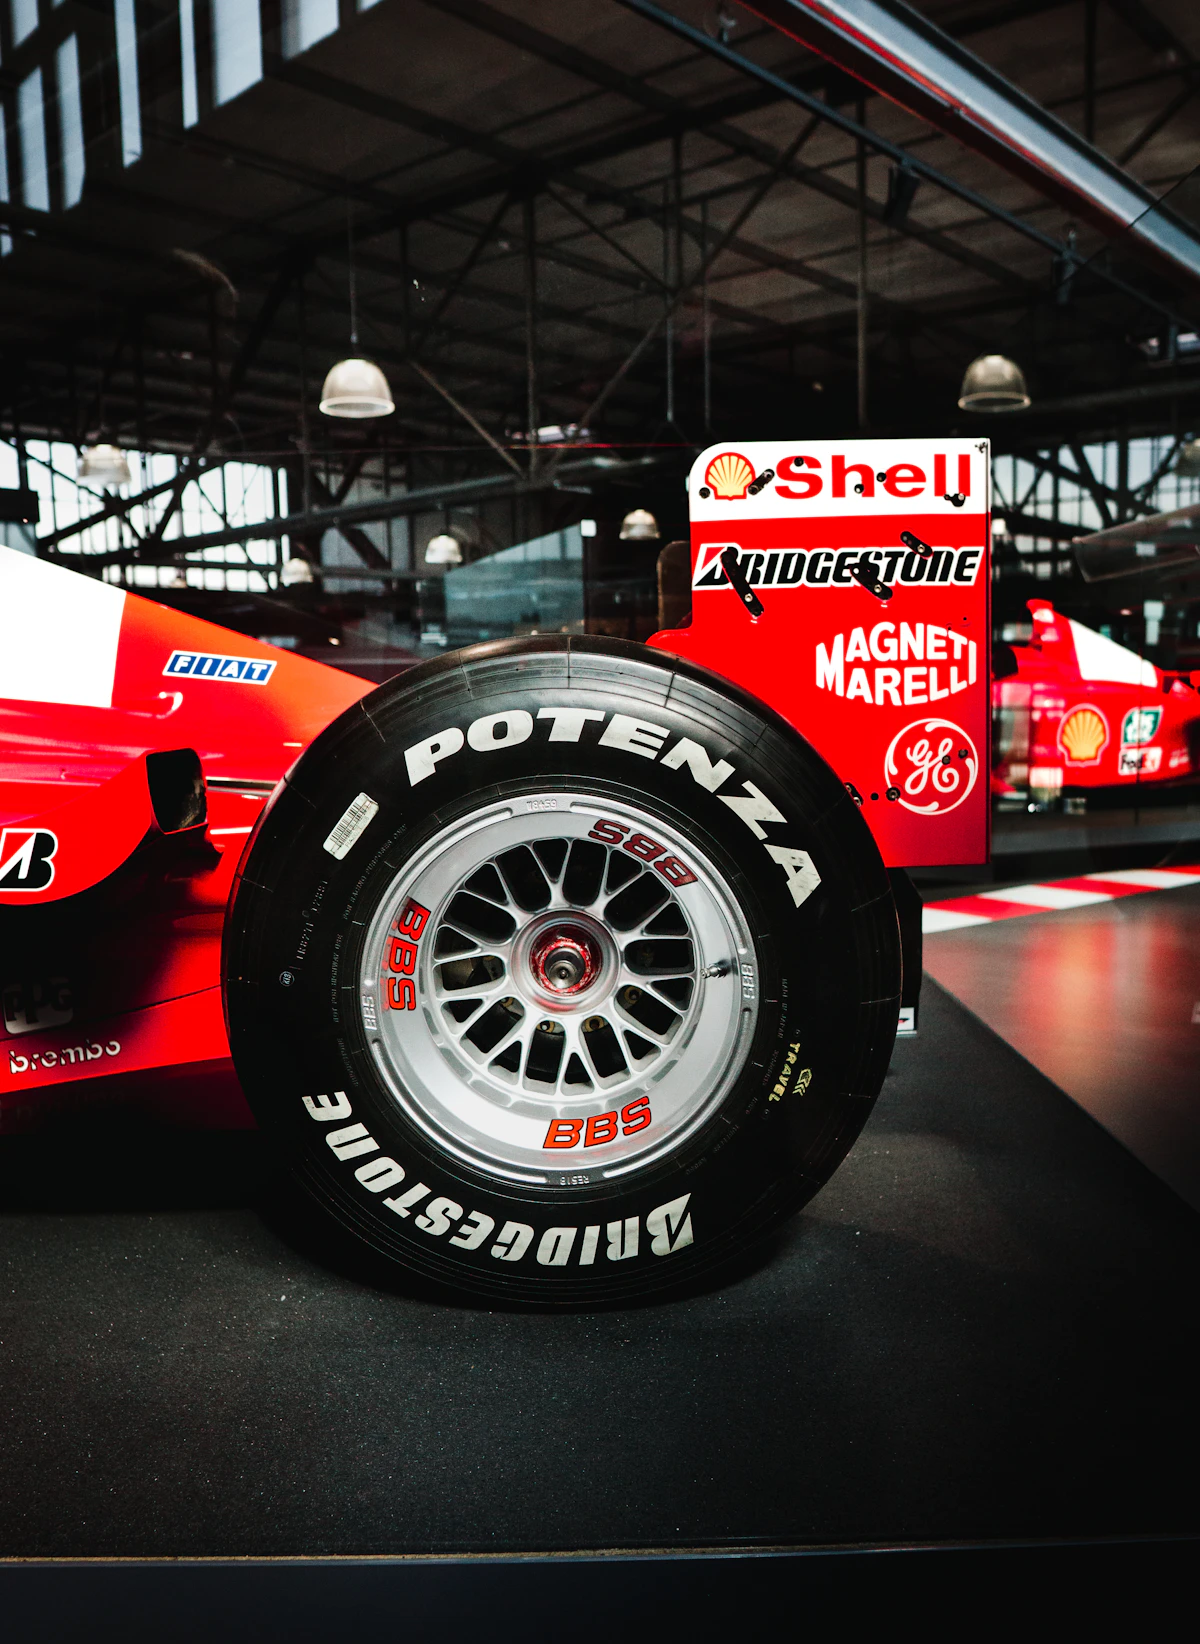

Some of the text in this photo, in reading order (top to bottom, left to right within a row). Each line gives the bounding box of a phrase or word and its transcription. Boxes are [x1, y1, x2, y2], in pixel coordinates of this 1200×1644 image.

[775, 453, 971, 500] Shell
[169, 654, 272, 681] FIAT
[816, 621, 977, 686] MAGNETI
[404, 707, 822, 908] POTENZA
[588, 819, 698, 887] BBS
[388, 895, 432, 1011] BBS
[362, 995, 377, 1031] BBS
[9, 1040, 121, 1074] brembo
[769, 1043, 801, 1102] TRAVEL
[543, 1096, 652, 1149] BBS
[301, 1091, 695, 1266] BRIDGESTONE
